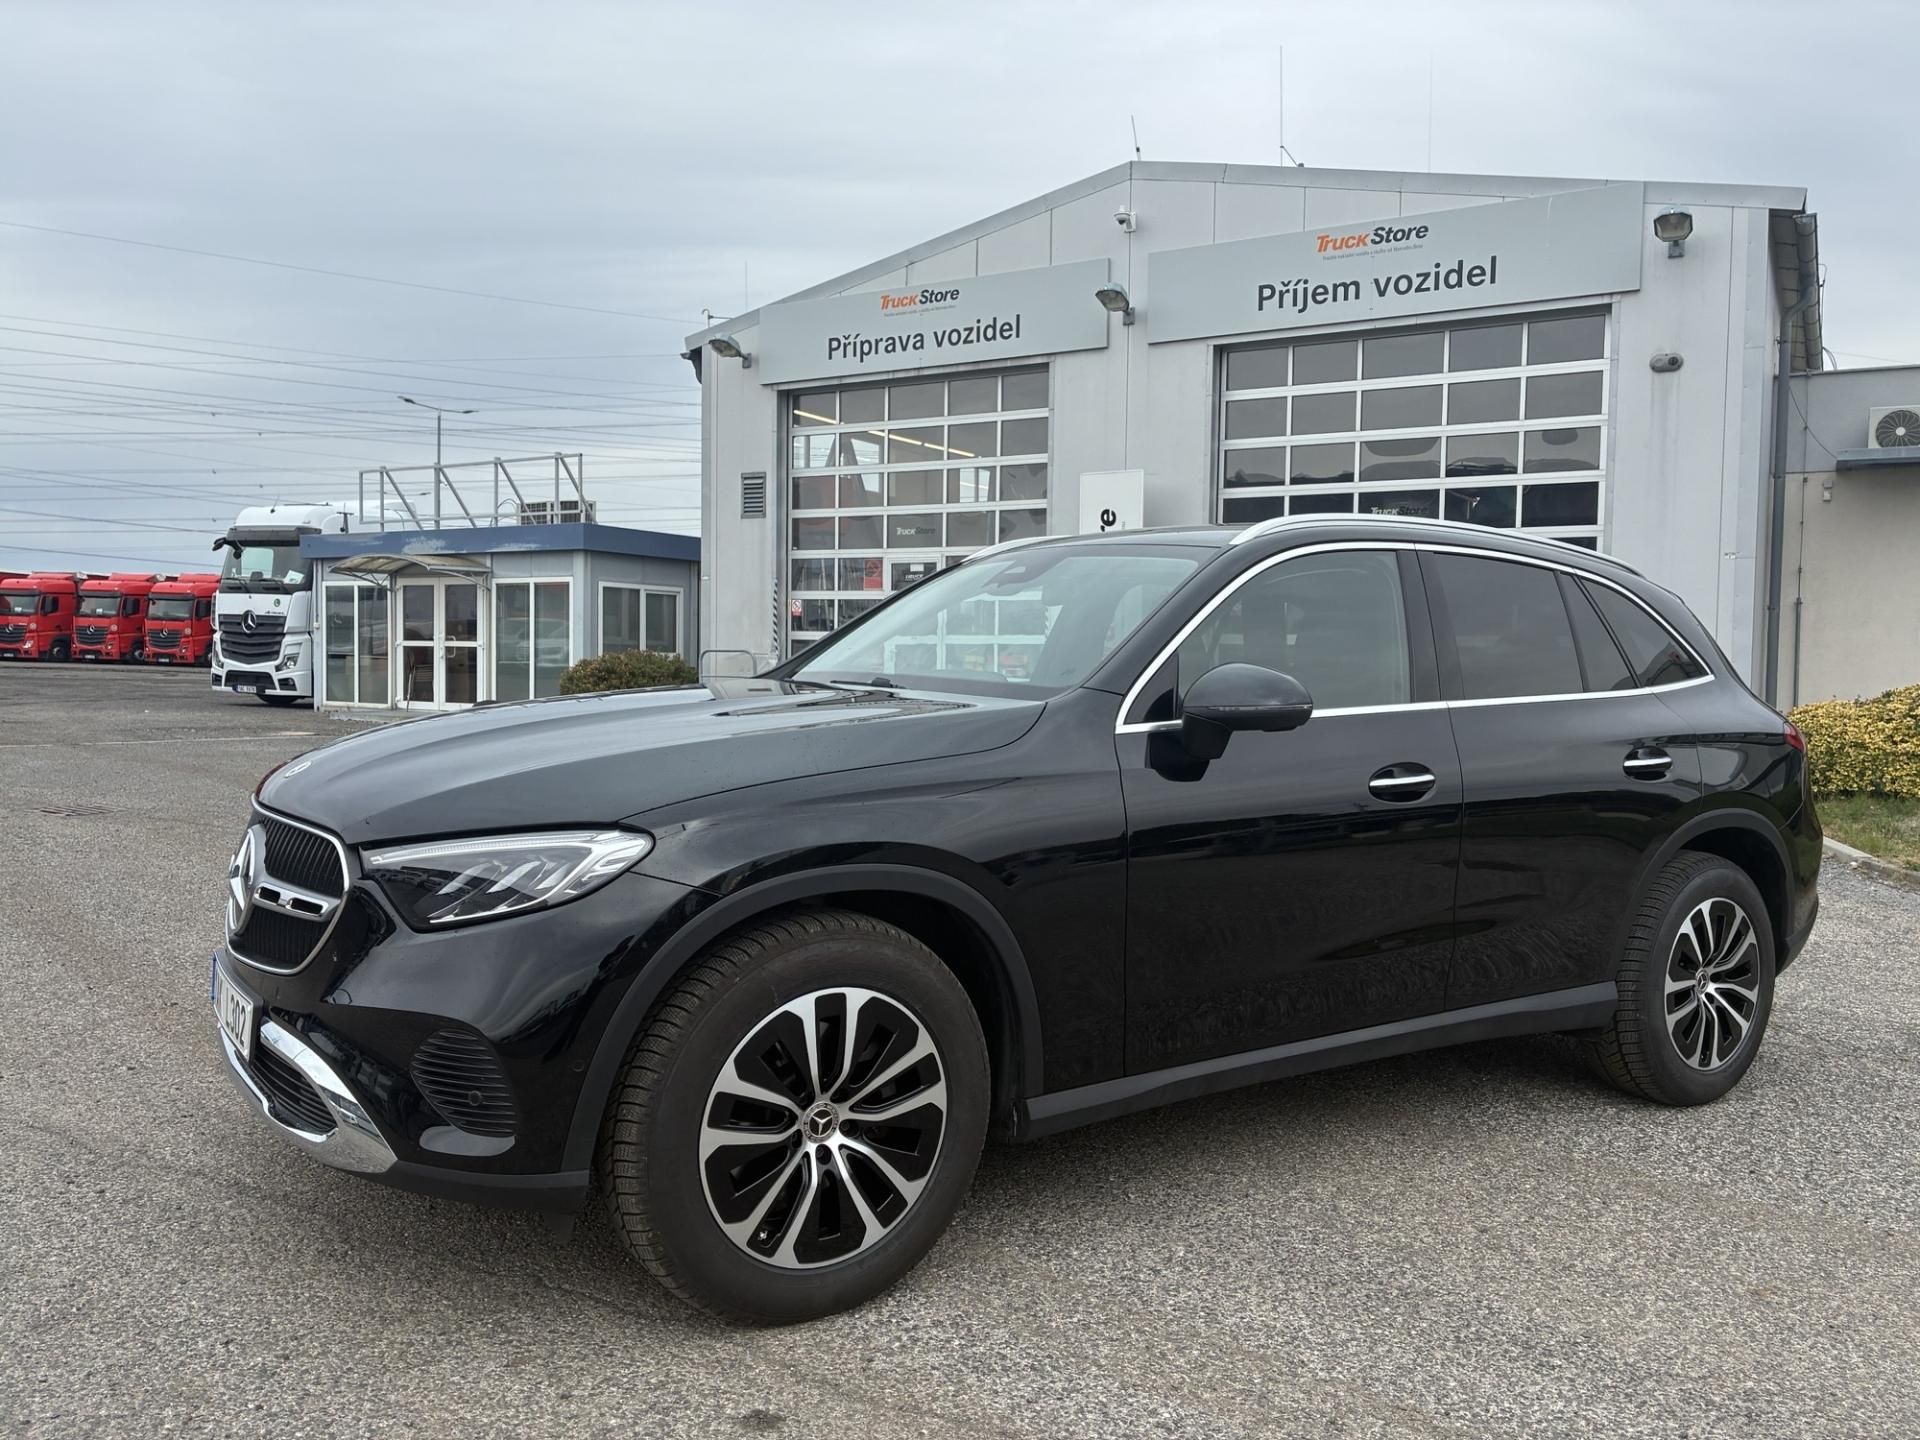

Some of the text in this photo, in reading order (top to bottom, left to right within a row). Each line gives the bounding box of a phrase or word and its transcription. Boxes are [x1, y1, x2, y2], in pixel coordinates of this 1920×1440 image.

[1257, 255, 1498, 314] Příjem vozidel
[828, 313, 1021, 363] Příprava vozidel
